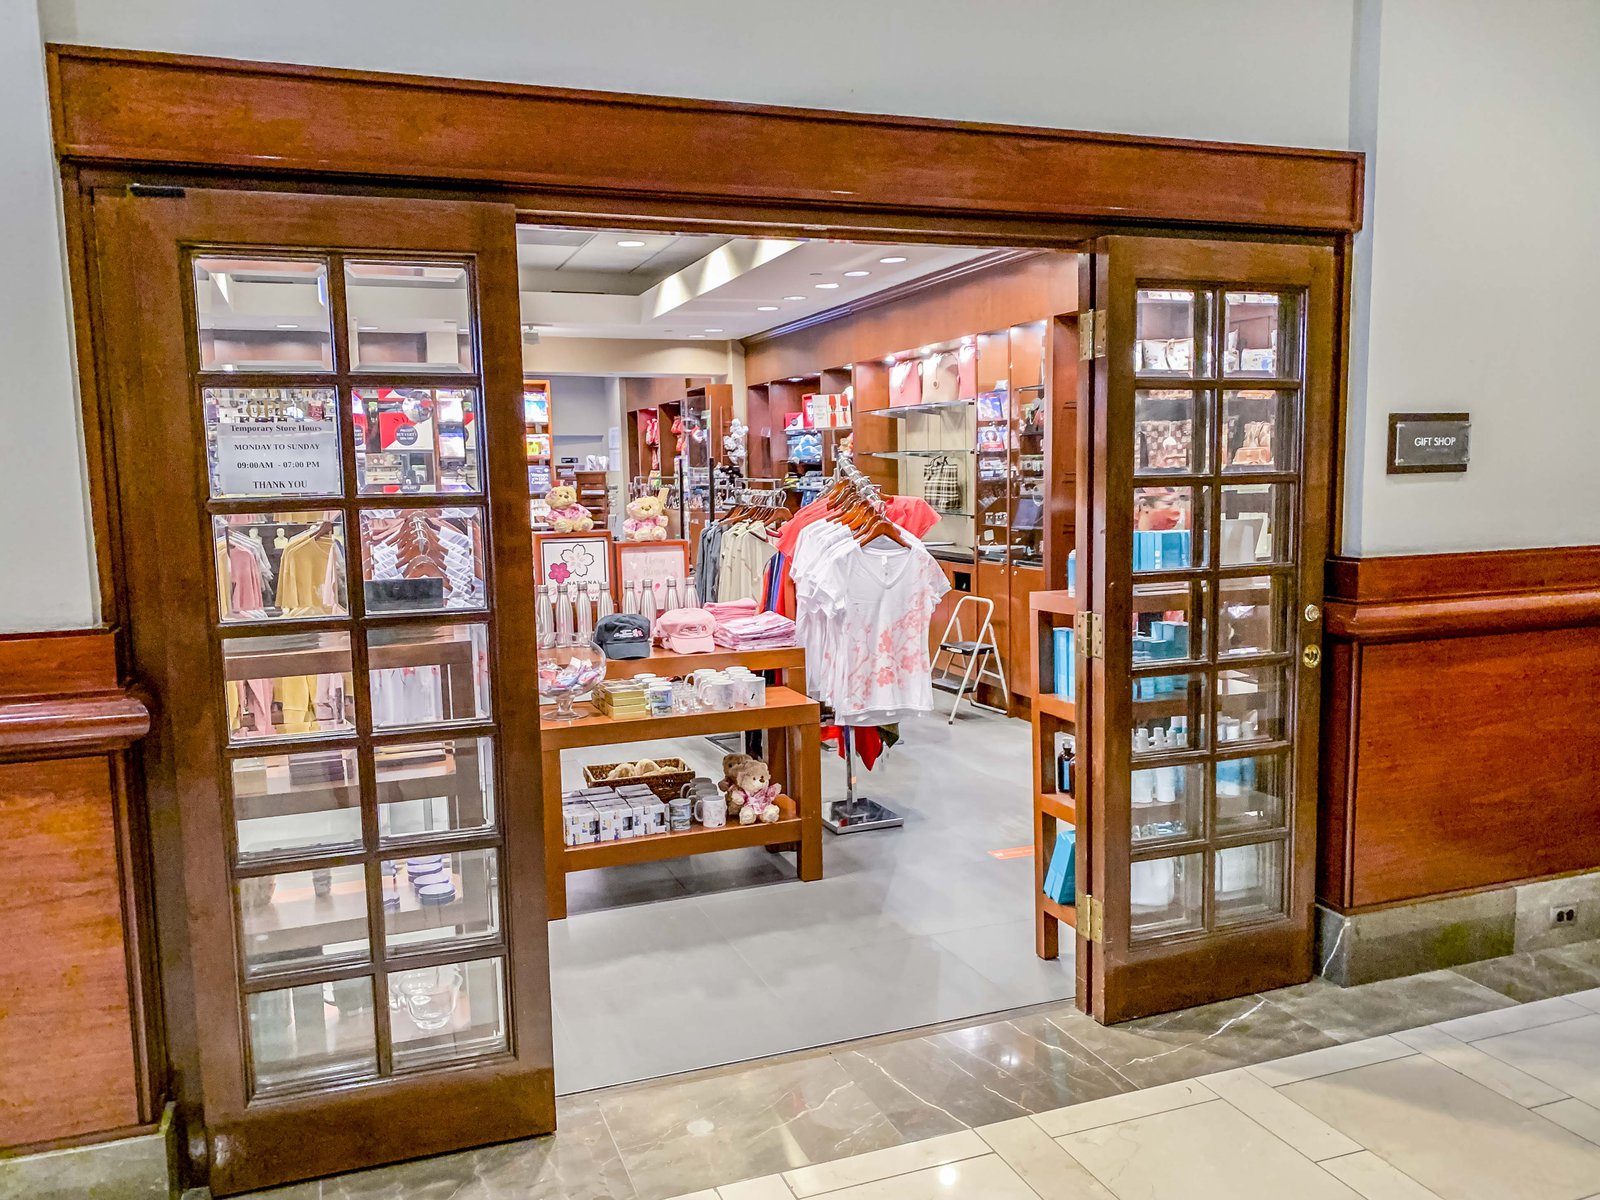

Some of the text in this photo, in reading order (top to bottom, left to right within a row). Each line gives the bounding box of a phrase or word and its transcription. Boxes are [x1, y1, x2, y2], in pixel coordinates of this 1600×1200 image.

[231, 424, 322, 433] Temporary Store Hours
[1414, 436, 1456, 447] GIFT SHOP
[234, 443, 320, 451] MONDAY TO SUNDAY
[237, 461, 273, 469] 09:00AM
[253, 480, 308, 489] THANK YOU
